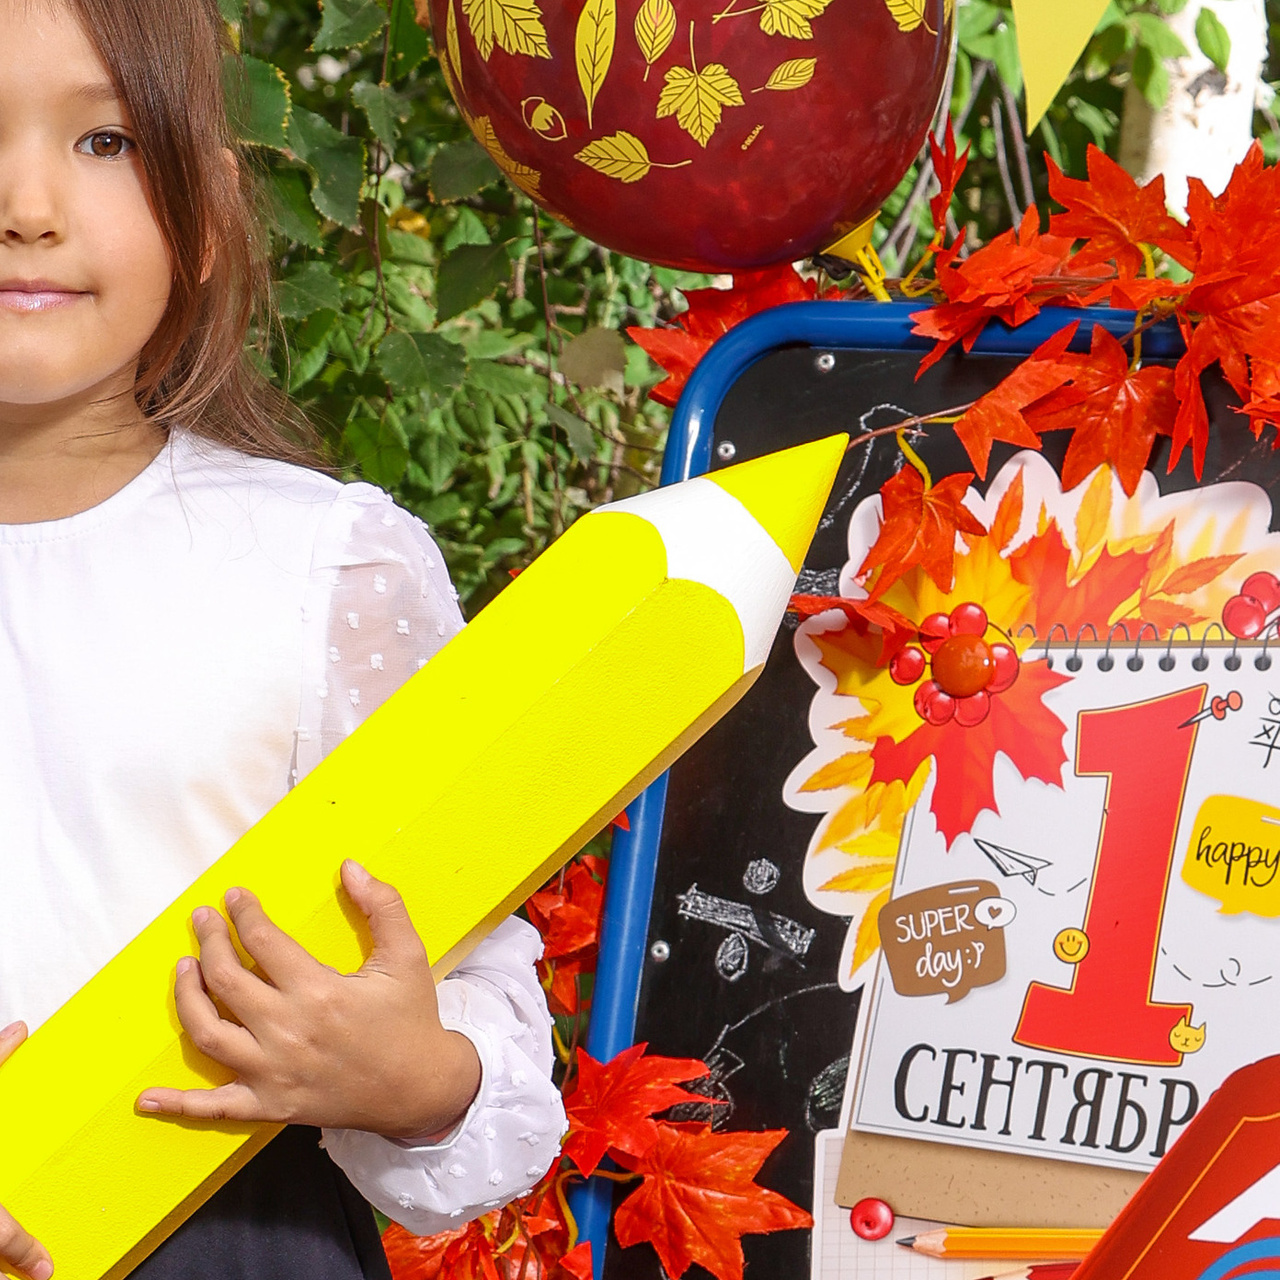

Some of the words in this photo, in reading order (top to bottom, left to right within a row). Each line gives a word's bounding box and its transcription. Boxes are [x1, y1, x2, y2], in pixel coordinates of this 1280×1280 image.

[1013, 683, 1209, 1067] 1
[1196, 826, 1280, 887] happy
[895, 904, 975, 943] SUPER
[893, 1043, 1200, 1158] СЕНТЯБР
